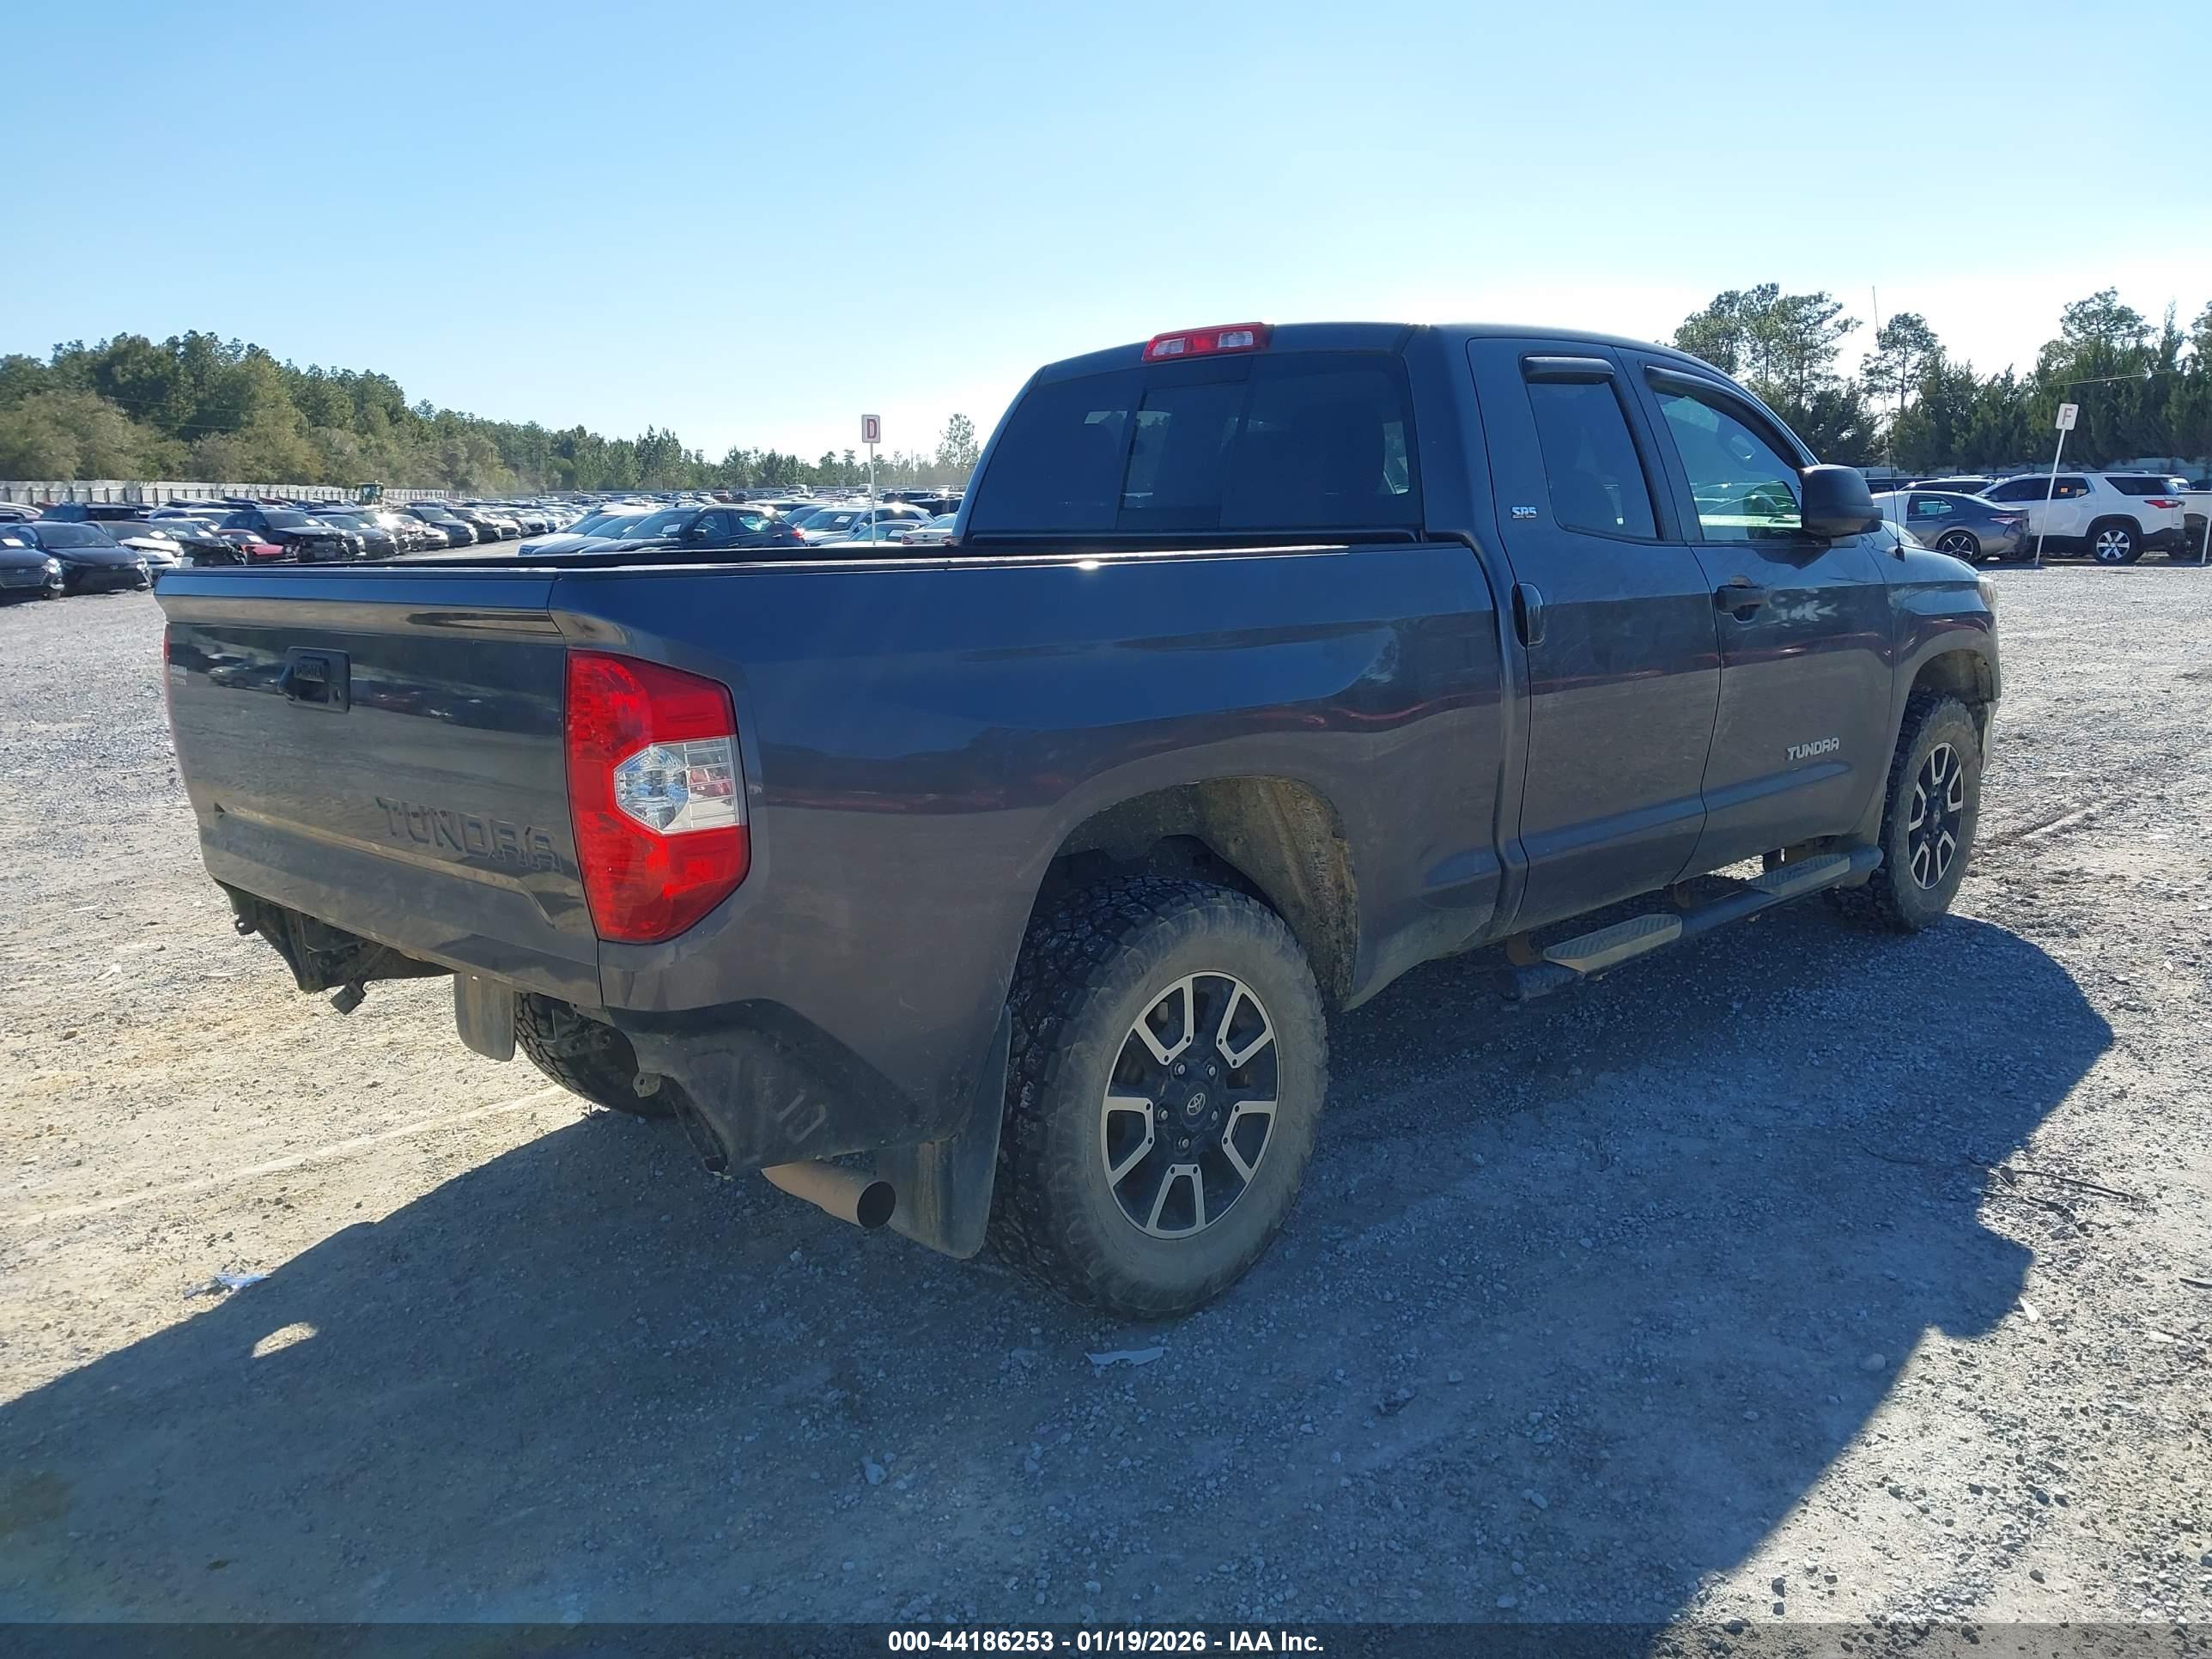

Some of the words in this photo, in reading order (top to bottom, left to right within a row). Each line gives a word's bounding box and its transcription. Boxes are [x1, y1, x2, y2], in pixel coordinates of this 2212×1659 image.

[2061, 408, 2074, 426] F
[866, 418, 878, 440] D
[1787, 737, 1840, 762] TUNDRA
[375, 796, 562, 873] TUNDRA
